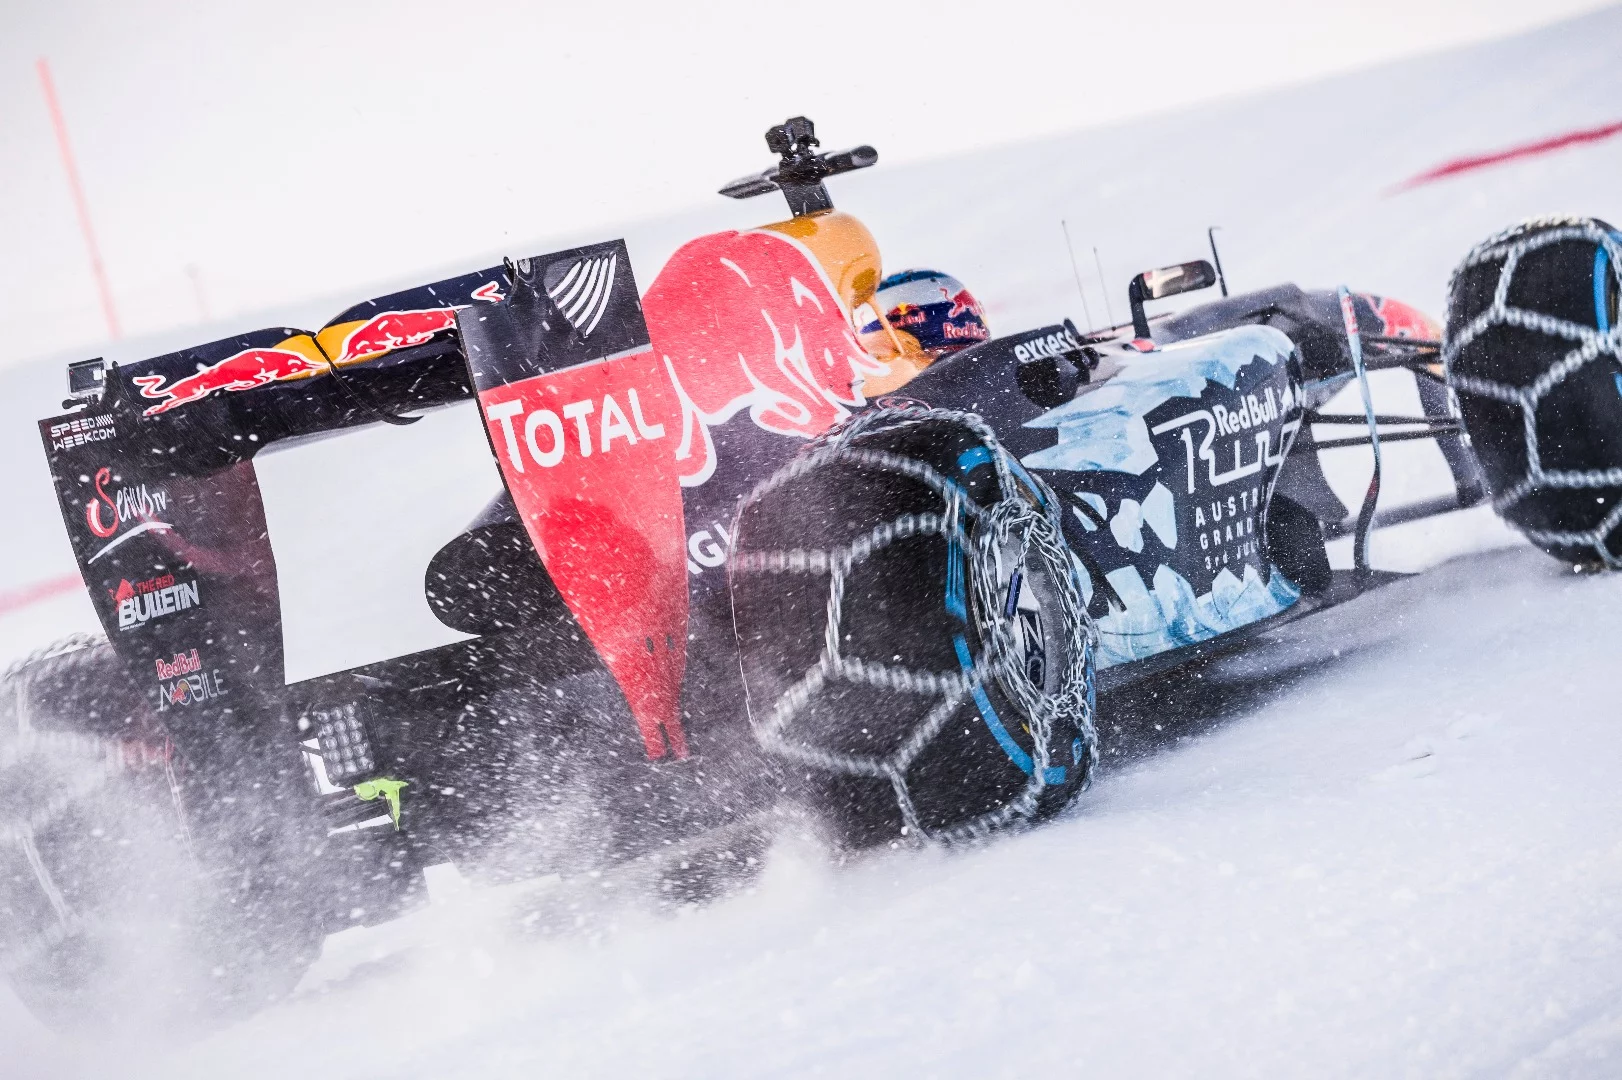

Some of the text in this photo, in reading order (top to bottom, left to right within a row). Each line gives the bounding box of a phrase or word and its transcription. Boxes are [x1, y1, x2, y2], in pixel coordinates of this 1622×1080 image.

[51, 418, 96, 438] SPEED
[486, 388, 665, 473] TOTAL
[1212, 387, 1278, 436] Red Bull
[119, 580, 200, 627] BULLETIN
[156, 648, 201, 680] Red Bull
[156, 669, 228, 712] MOBILE
